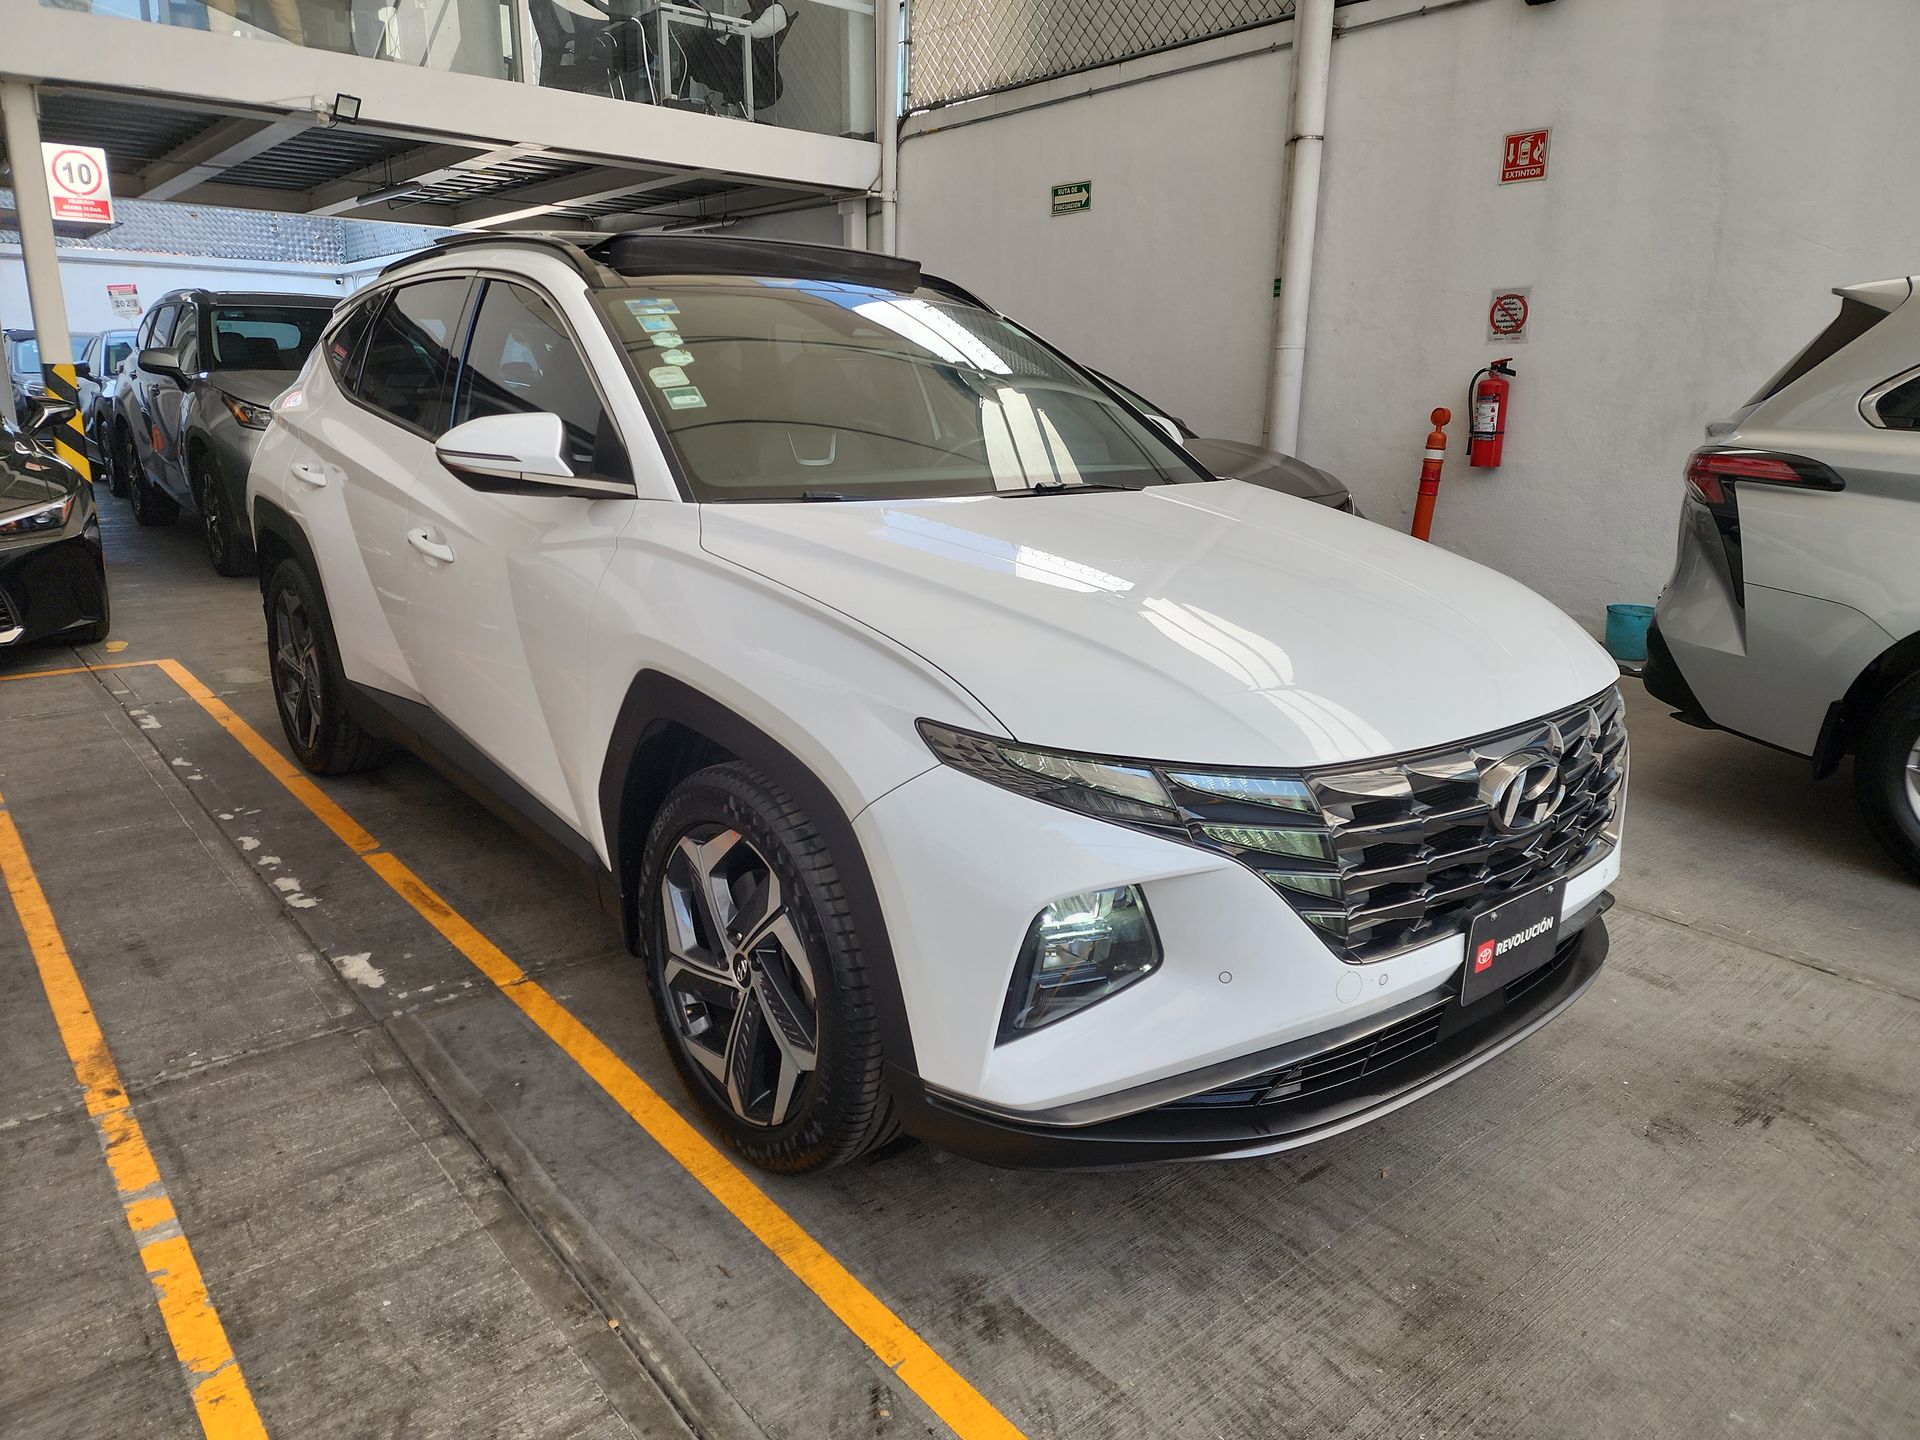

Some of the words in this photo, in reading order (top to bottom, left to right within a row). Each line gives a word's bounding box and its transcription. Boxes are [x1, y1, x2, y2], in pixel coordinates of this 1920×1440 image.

[62, 162, 92, 185] 10
[1505, 168, 1541, 179] EXTINTOR
[1057, 187, 1071, 196] RUTA
[1071, 186, 1078, 194] DE
[1495, 916, 1554, 957] REVOLUCIÓN
